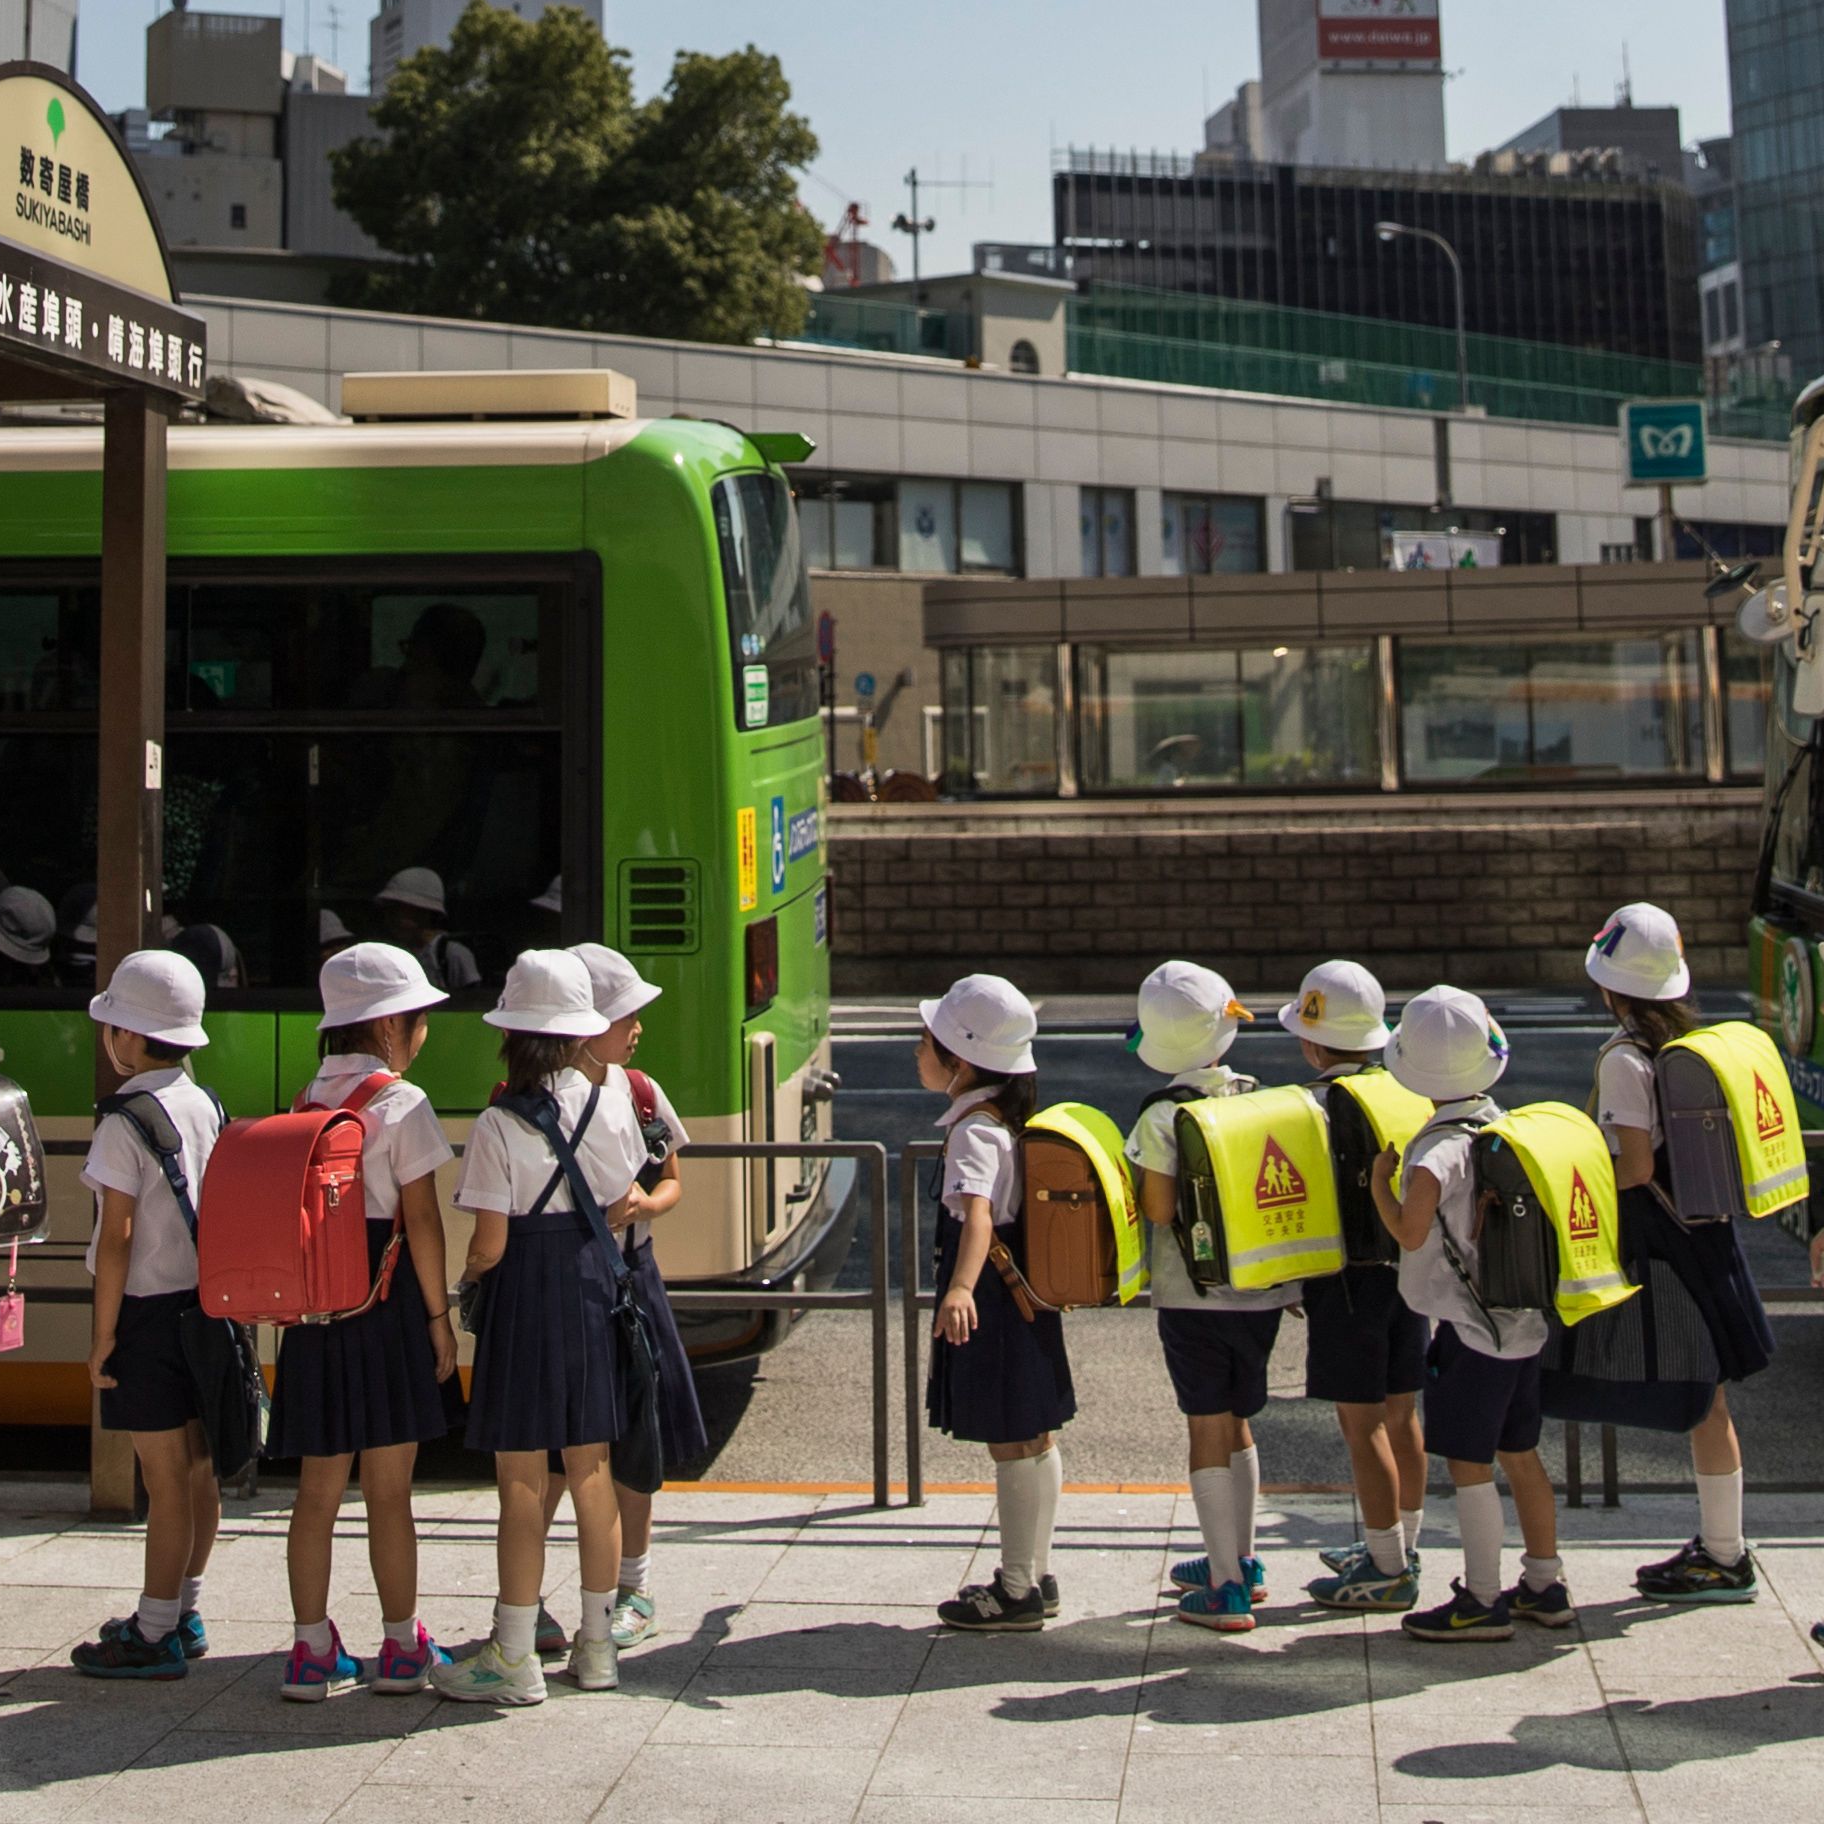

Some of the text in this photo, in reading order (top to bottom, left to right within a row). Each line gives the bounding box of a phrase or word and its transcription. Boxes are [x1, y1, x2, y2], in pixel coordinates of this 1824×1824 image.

[18, 145, 92, 214] 数寄屋橋
[15, 191, 92, 247] SUKIYABASHI
